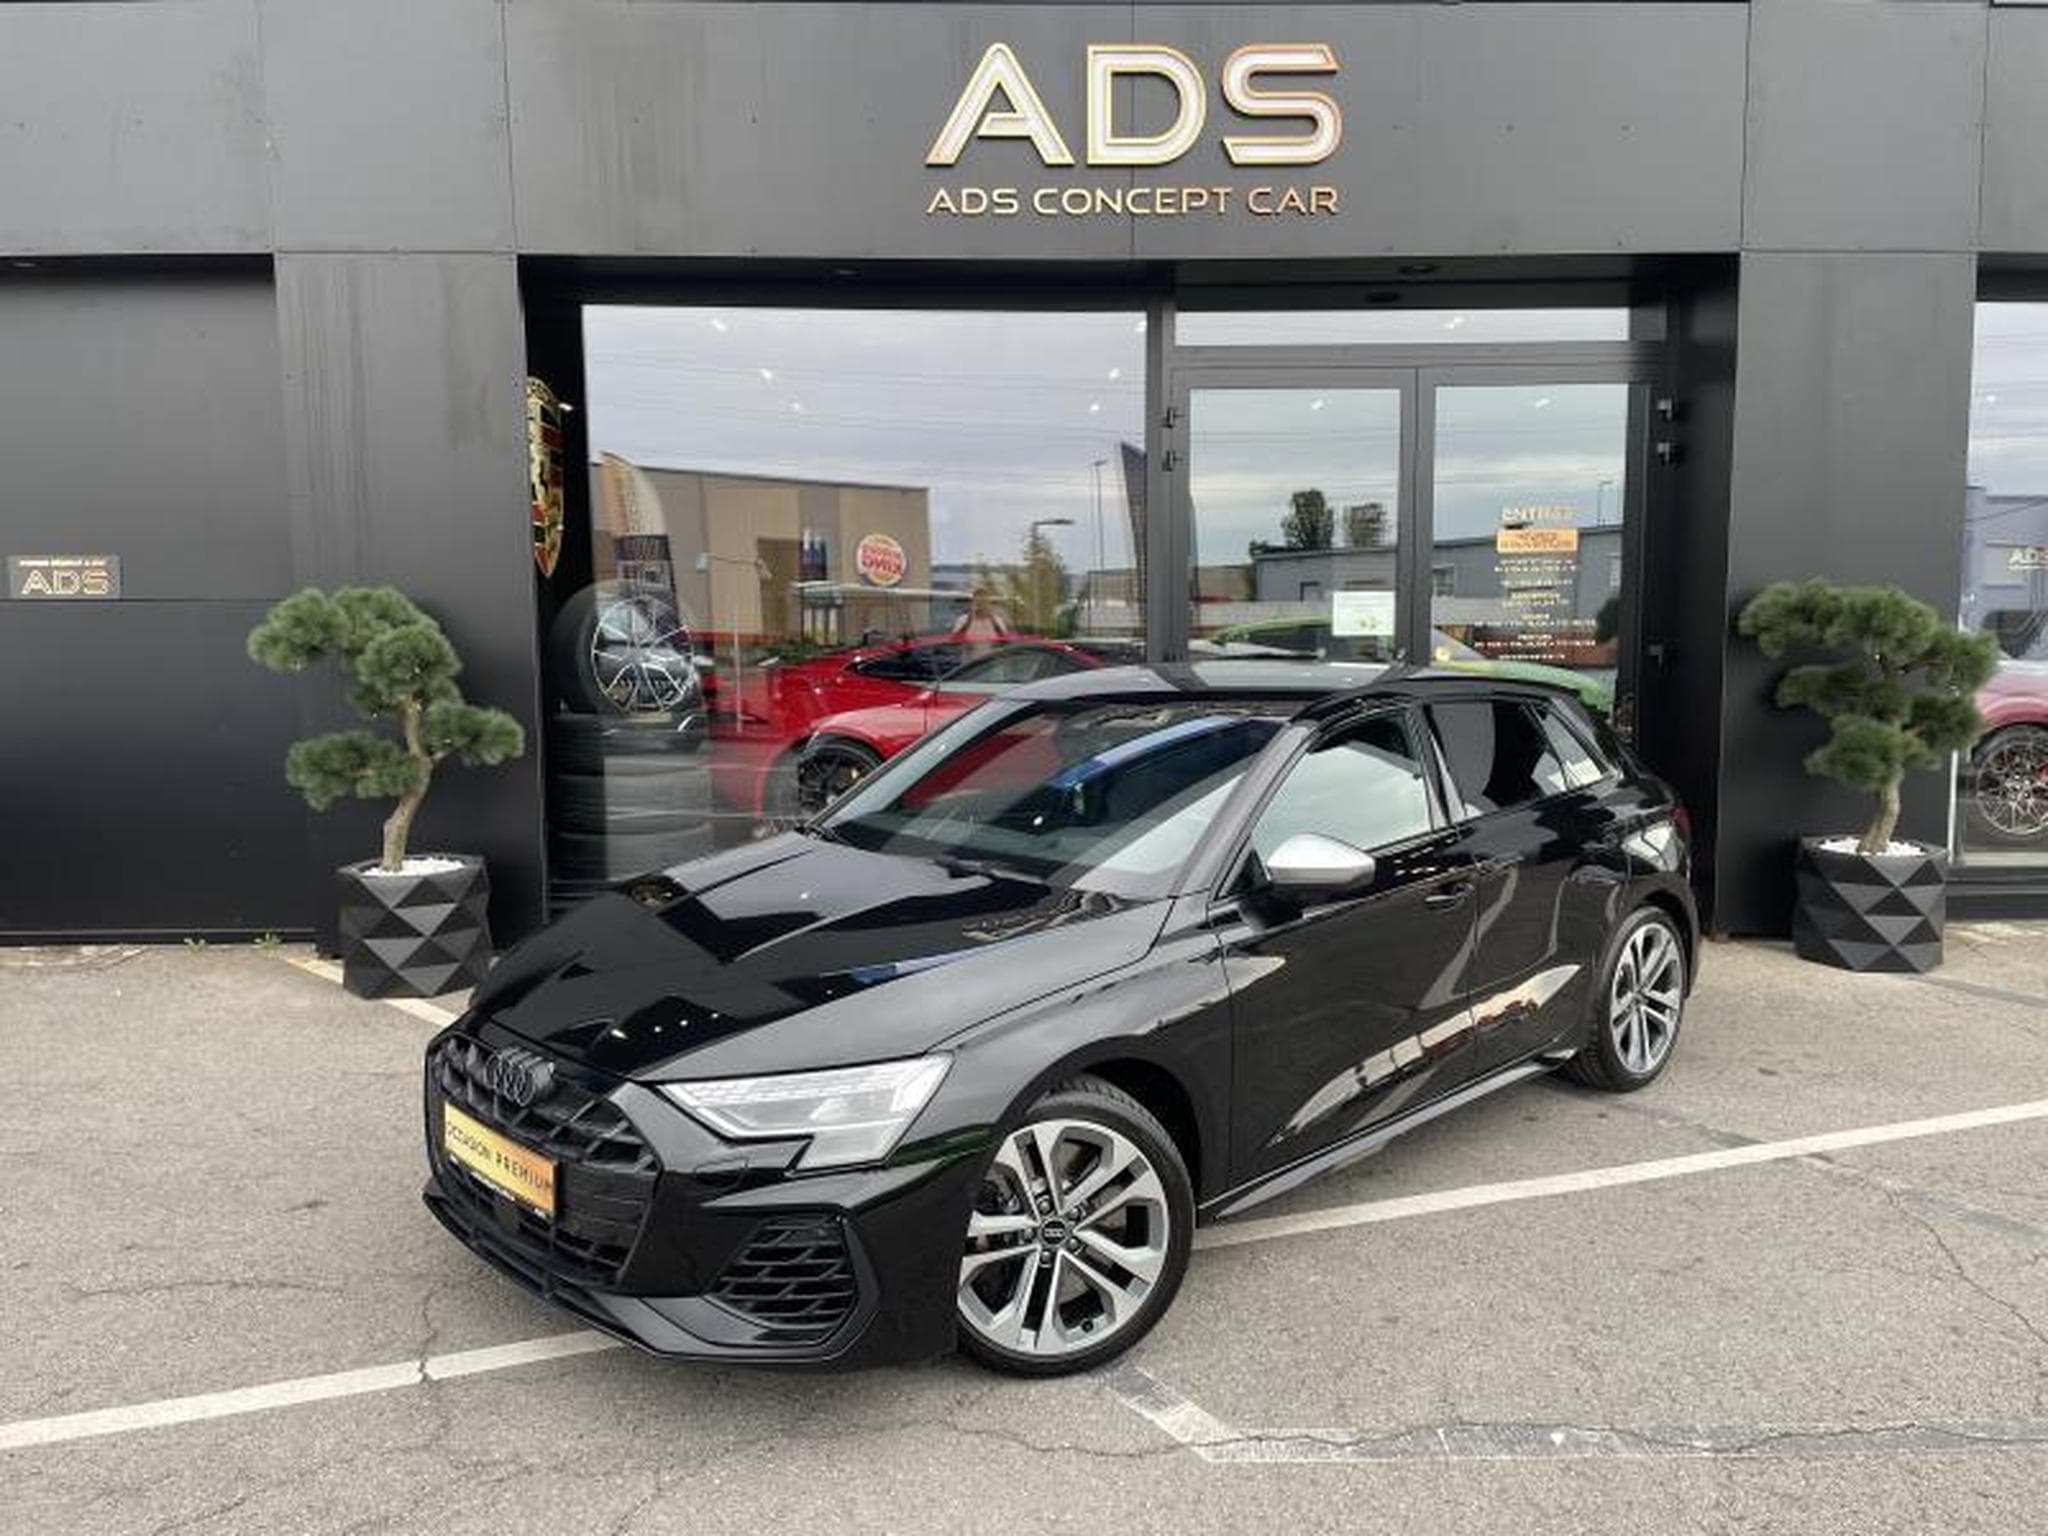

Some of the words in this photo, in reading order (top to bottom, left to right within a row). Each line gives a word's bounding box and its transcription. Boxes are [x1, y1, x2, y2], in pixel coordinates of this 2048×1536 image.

[924, 42, 1342, 166] ADS
[926, 188, 1018, 215] ADS
[1033, 187, 1232, 215] CONCEPT
[1247, 186, 1339, 215] CAR
[21, 569, 108, 595] ADS
